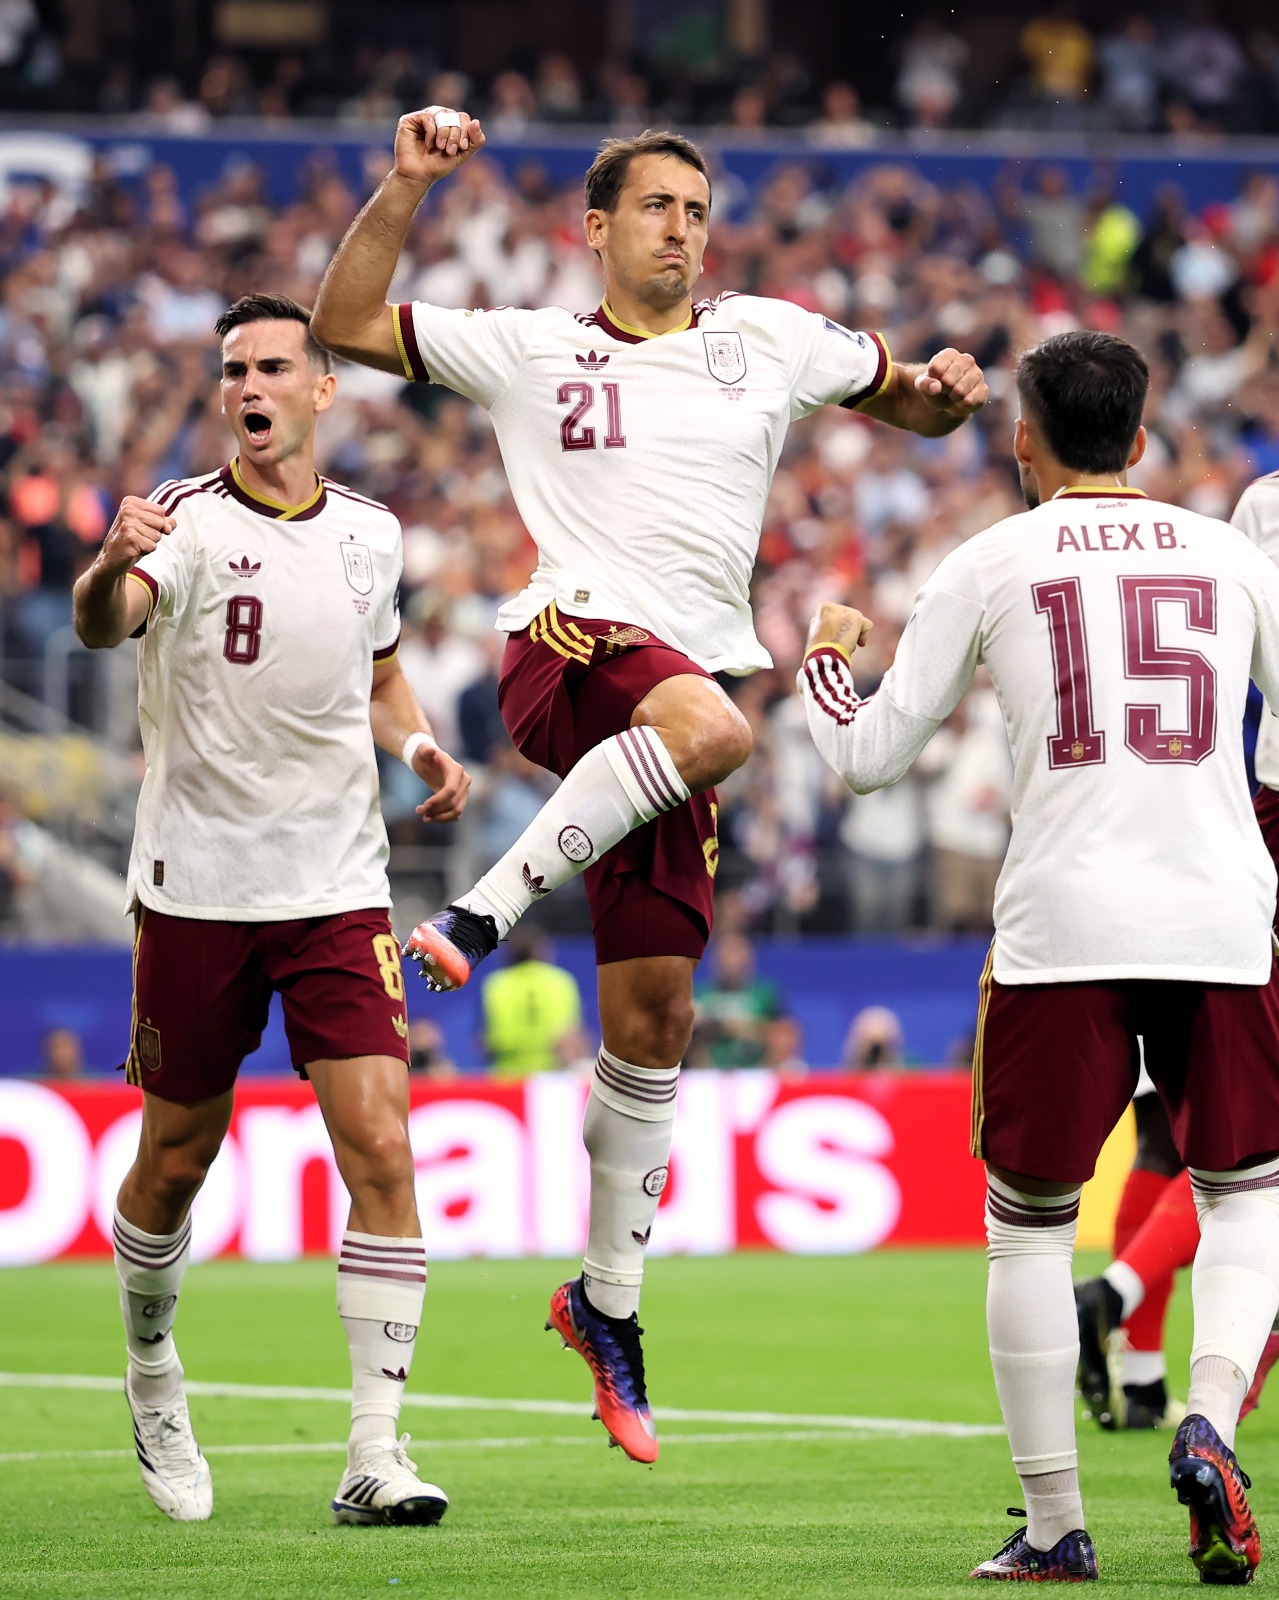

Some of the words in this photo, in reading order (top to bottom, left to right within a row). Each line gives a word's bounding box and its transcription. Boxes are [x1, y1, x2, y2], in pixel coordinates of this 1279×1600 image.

[557, 381, 626, 452] 21
[1056, 523, 1145, 552] ALEX
[1153, 522, 1187, 549] B.
[223, 594, 263, 665] 8
[1031, 575, 1217, 770] 15
[372, 933, 404, 1001] 8
